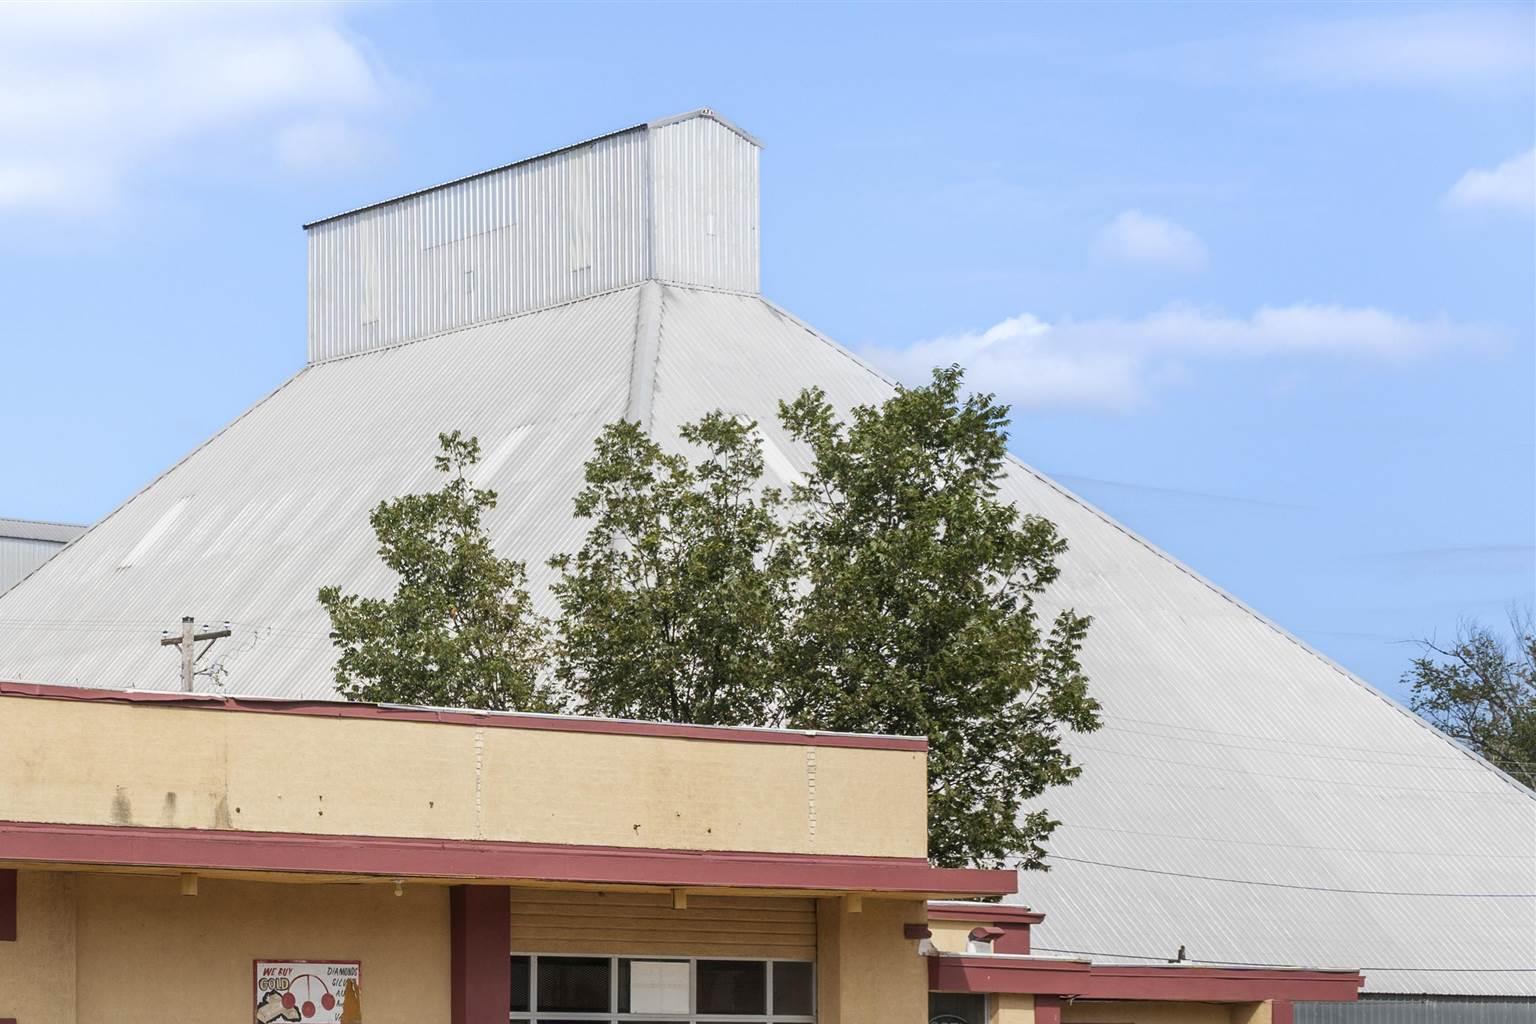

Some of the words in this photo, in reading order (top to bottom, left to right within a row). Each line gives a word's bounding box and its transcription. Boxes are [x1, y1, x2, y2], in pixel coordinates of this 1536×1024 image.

[263, 968, 275, 976] WE
[278, 968, 293, 976] BUY
[327, 967, 358, 976] DIAMONDS
[259, 978, 289, 991] GOLD
